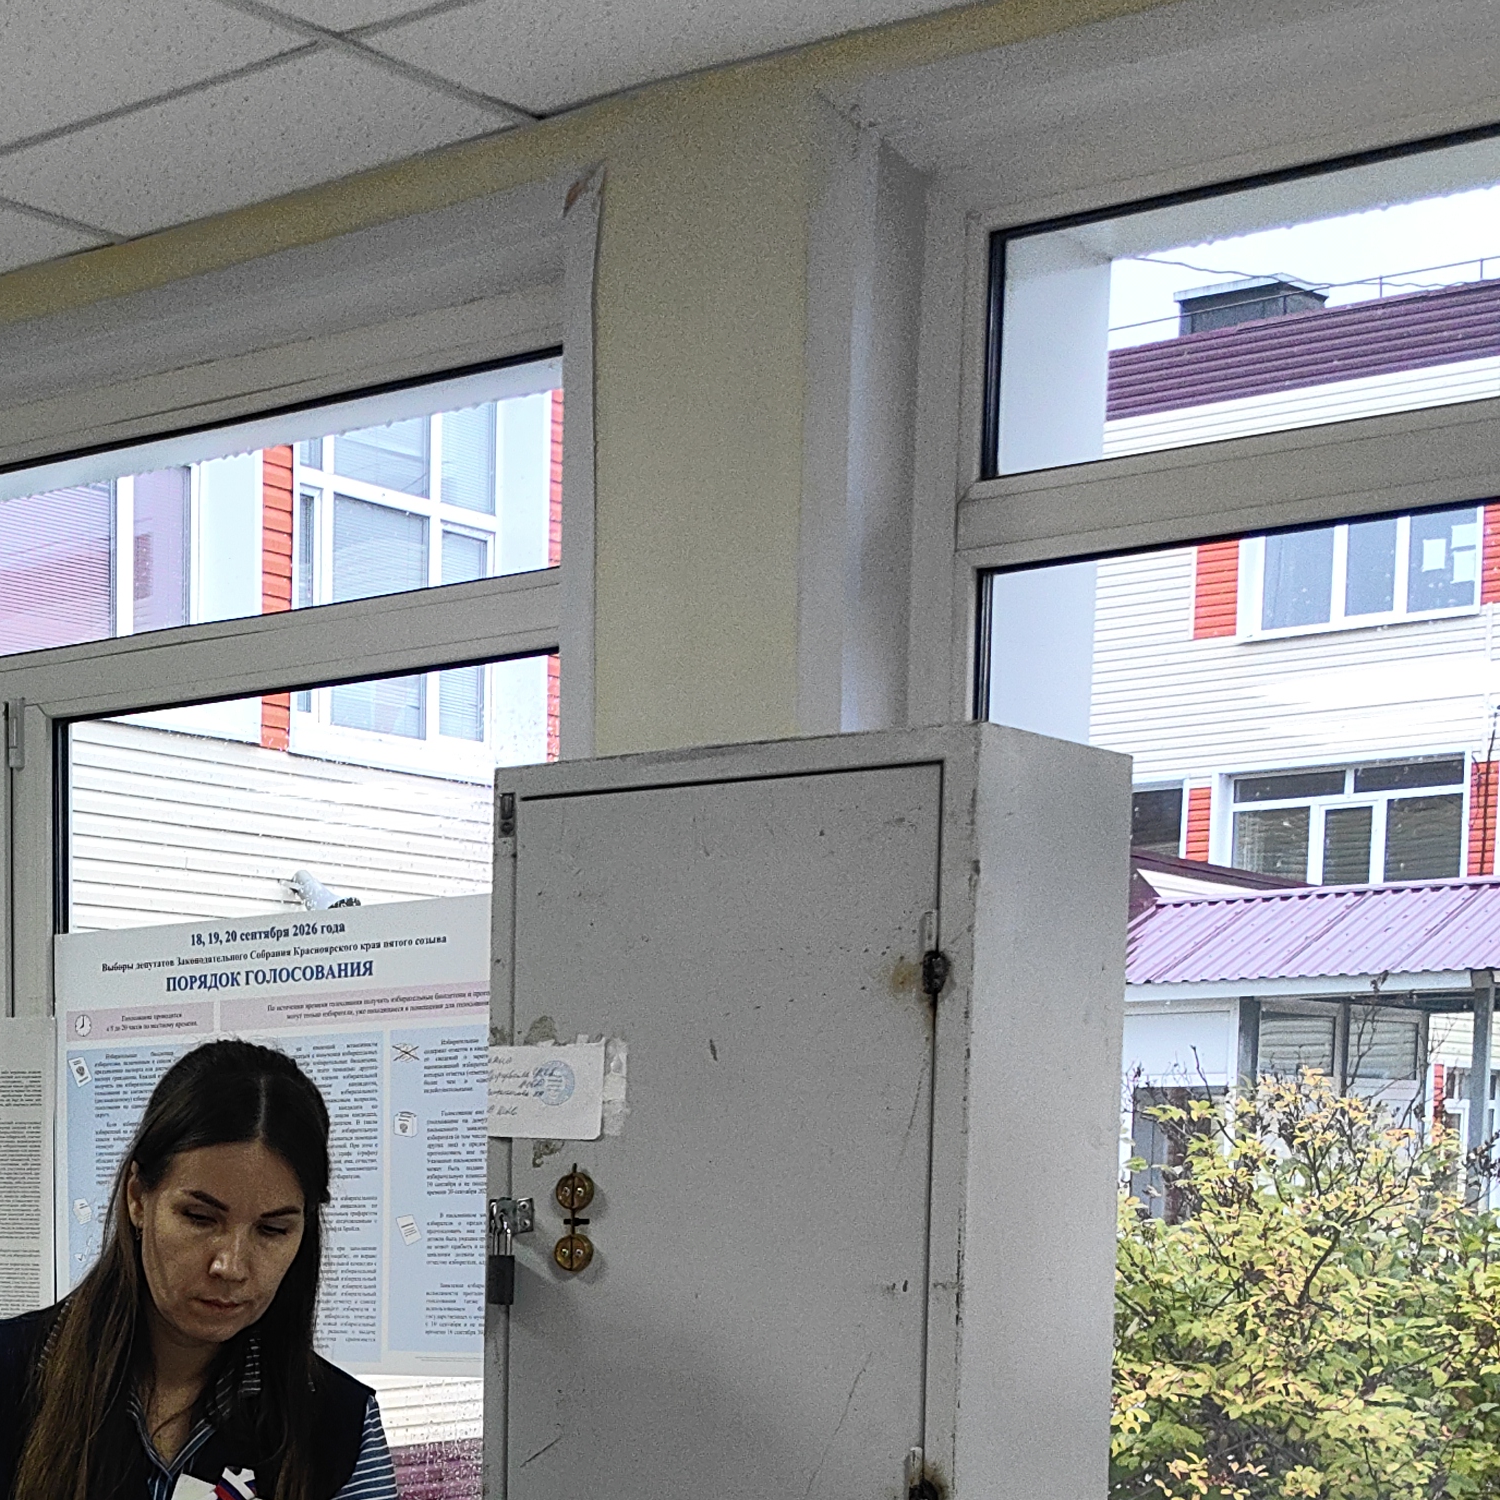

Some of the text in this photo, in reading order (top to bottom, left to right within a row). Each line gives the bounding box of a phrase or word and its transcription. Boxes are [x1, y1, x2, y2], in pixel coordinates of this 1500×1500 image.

[191, 922, 345, 947] 18, 19, 20 сентября 2026 года
[250, 949, 291, 961] Собрания
[293, 942, 358, 958] Красноярского
[360, 941, 381, 951] края
[383, 938, 413, 948] пятого
[415, 935, 447, 946] созыва
[166, 960, 374, 992] ПОРЯДОК ГОЛОСОВАНИЯ
